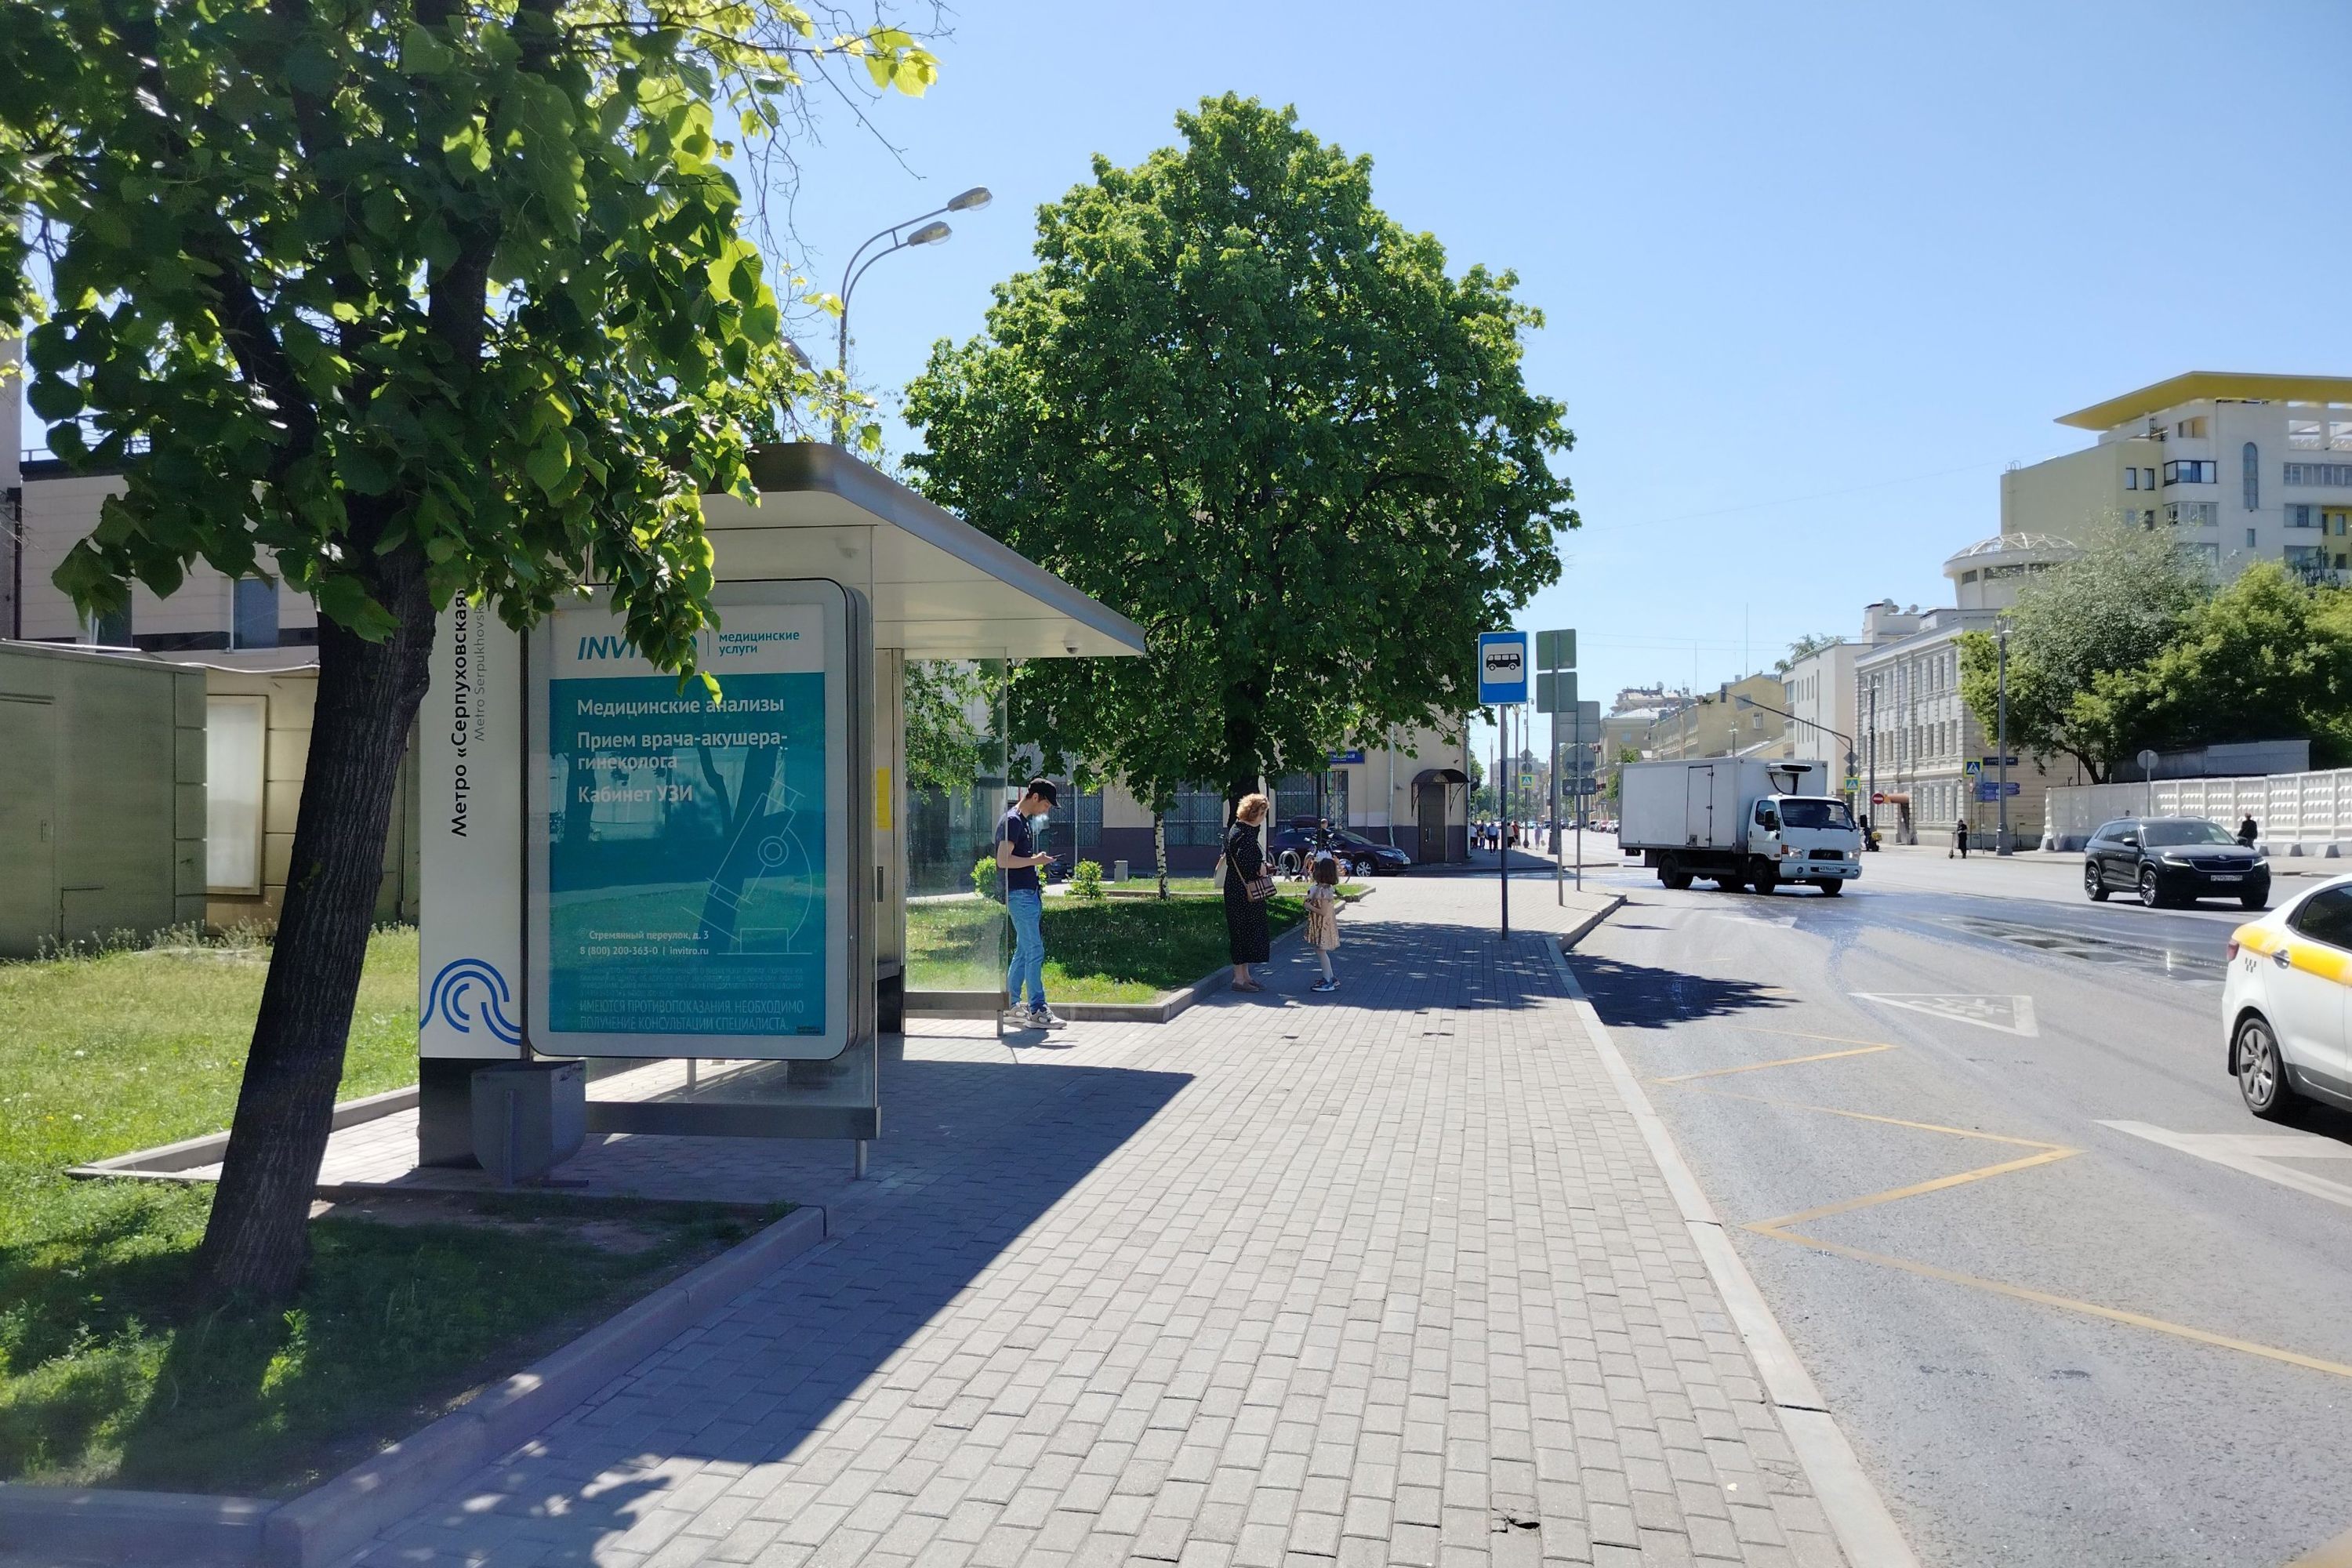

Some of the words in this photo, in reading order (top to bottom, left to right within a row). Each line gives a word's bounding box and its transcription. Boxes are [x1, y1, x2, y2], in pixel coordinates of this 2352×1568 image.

[719, 630, 800, 643] медицинские
[719, 644, 757, 657] услуги
[577, 699, 700, 717] Медицинские
[706, 699, 784, 713] анализы
[475, 699, 485, 742] Metro
[577, 731, 636, 751] Прием
[642, 731, 787, 750] врача-акушера-
[578, 755, 677, 770] гинеколога
[452, 764, 470, 837] Метро
[579, 786, 652, 803] Кабинет
[655, 785, 692, 802] УЗИ
[589, 930, 644, 940] Стремянный
[703, 930, 710, 939] 3
[579, 946, 586, 955] 8
[587, 946, 610, 956] (800)
[612, 946, 658, 956] 200-363-0
[670, 946, 709, 955] invitro.ru
[580, 1000, 626, 1013] ИМЕЮТСЯ
[735, 1000, 804, 1014] НЕОБХОДИМО
[580, 1016, 637, 1030] ПОЛУЧЕНИЕ
[639, 1017, 713, 1031] КОНСУЛЬТАЦИИ
[715, 1017, 789, 1032] СПЕЦИАЛИСТА.
